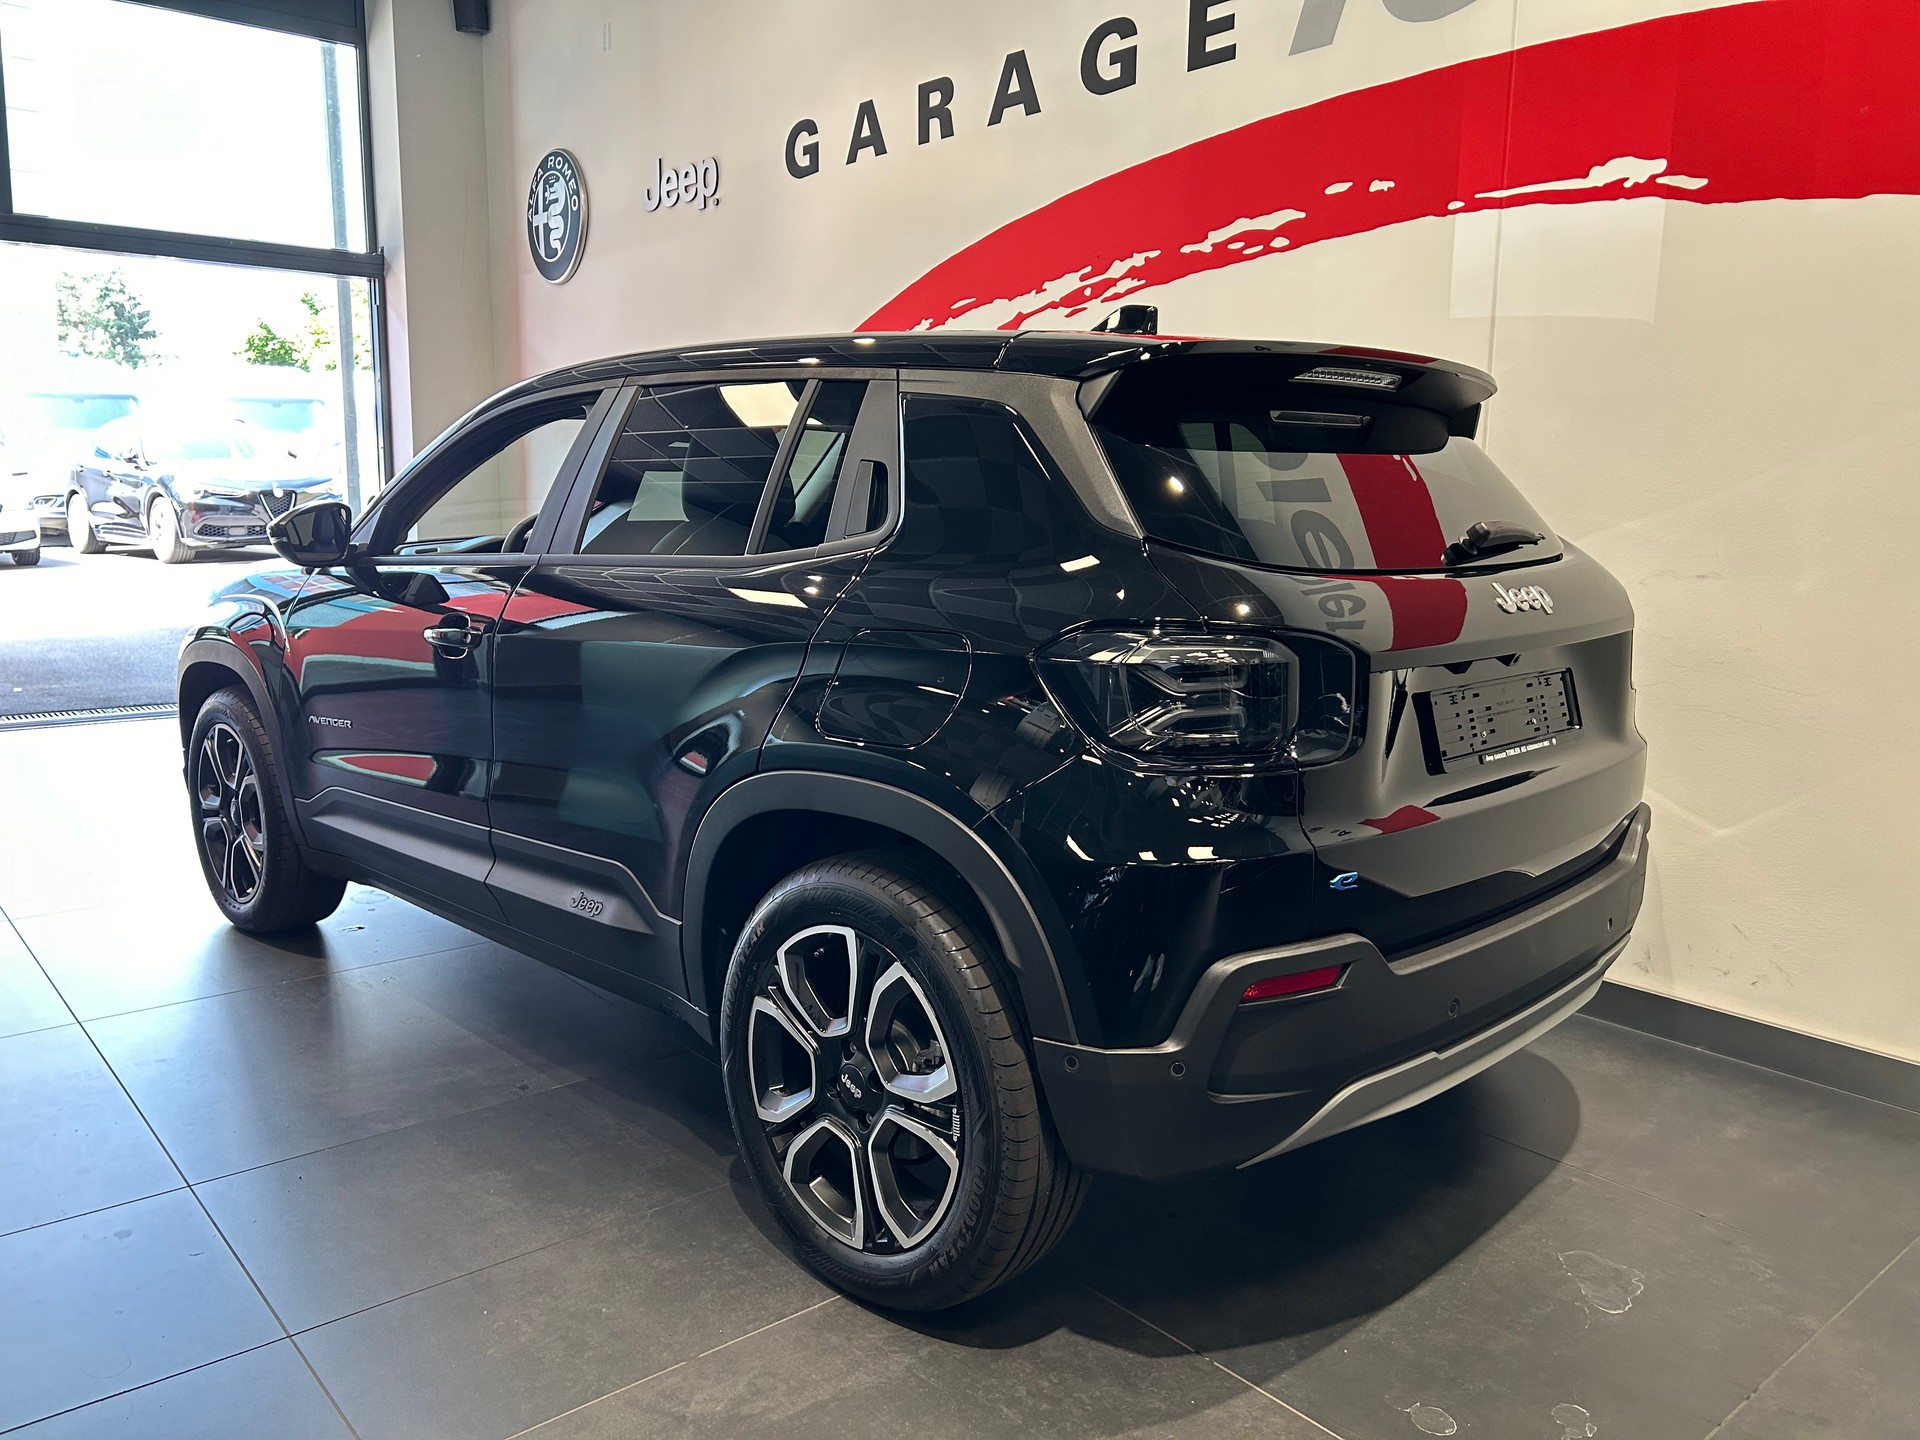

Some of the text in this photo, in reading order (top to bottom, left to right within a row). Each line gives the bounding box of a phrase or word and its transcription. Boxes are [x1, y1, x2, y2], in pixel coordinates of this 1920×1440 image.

[784, 0, 1238, 179] GARAGE
[527, 155, 579, 222] ALFA ROMEO
[643, 157, 720, 212] Jeep
[1491, 582, 1554, 616] Jeep
[309, 715, 353, 729] AVENGER
[570, 891, 604, 917] Jeep
[841, 1073, 863, 1099] Jeep
[928, 1159, 987, 1279] GOODYEAR
